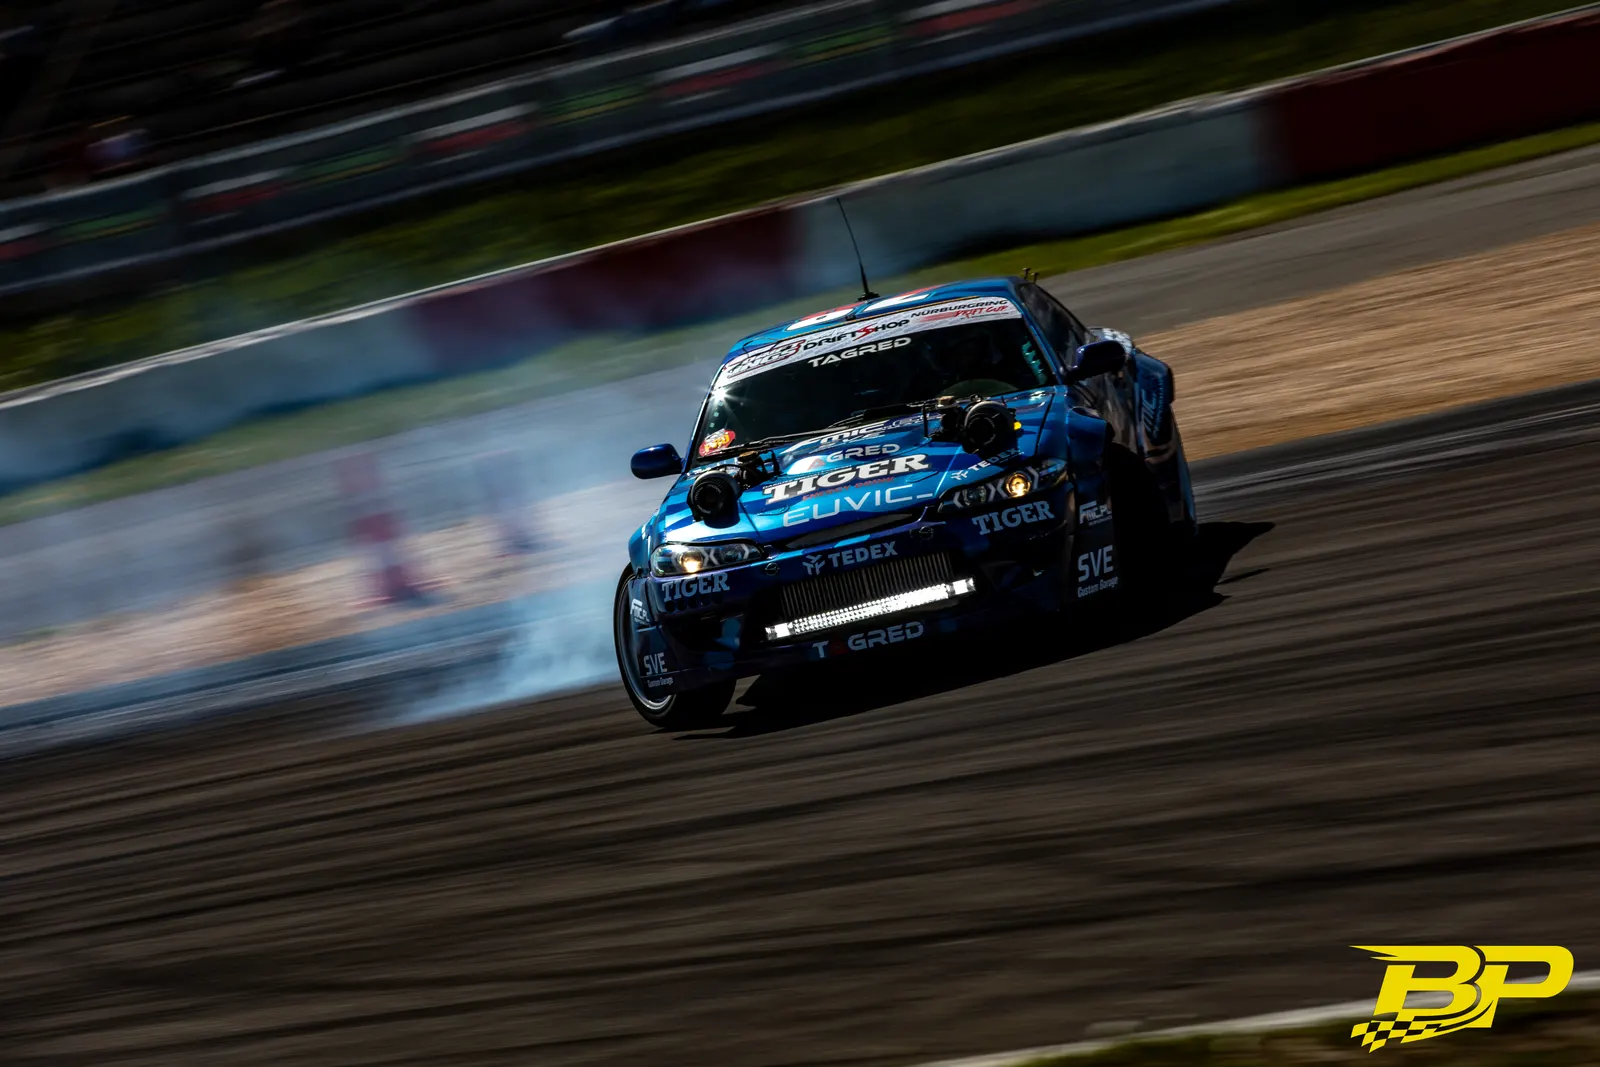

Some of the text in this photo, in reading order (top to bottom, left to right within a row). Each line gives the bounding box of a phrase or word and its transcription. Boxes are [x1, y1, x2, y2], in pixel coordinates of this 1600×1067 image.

[807, 336, 912, 368] TAGRED
[968, 448, 1020, 471] TEDEX
[763, 453, 930, 505] TIGER
[971, 500, 1055, 536] TIGER
[827, 541, 898, 568] TEDEX
[1078, 544, 1114, 583] SVE
[661, 572, 730, 602] TIGER
[811, 621, 924, 658] TGRED
[643, 652, 668, 676] SVE
